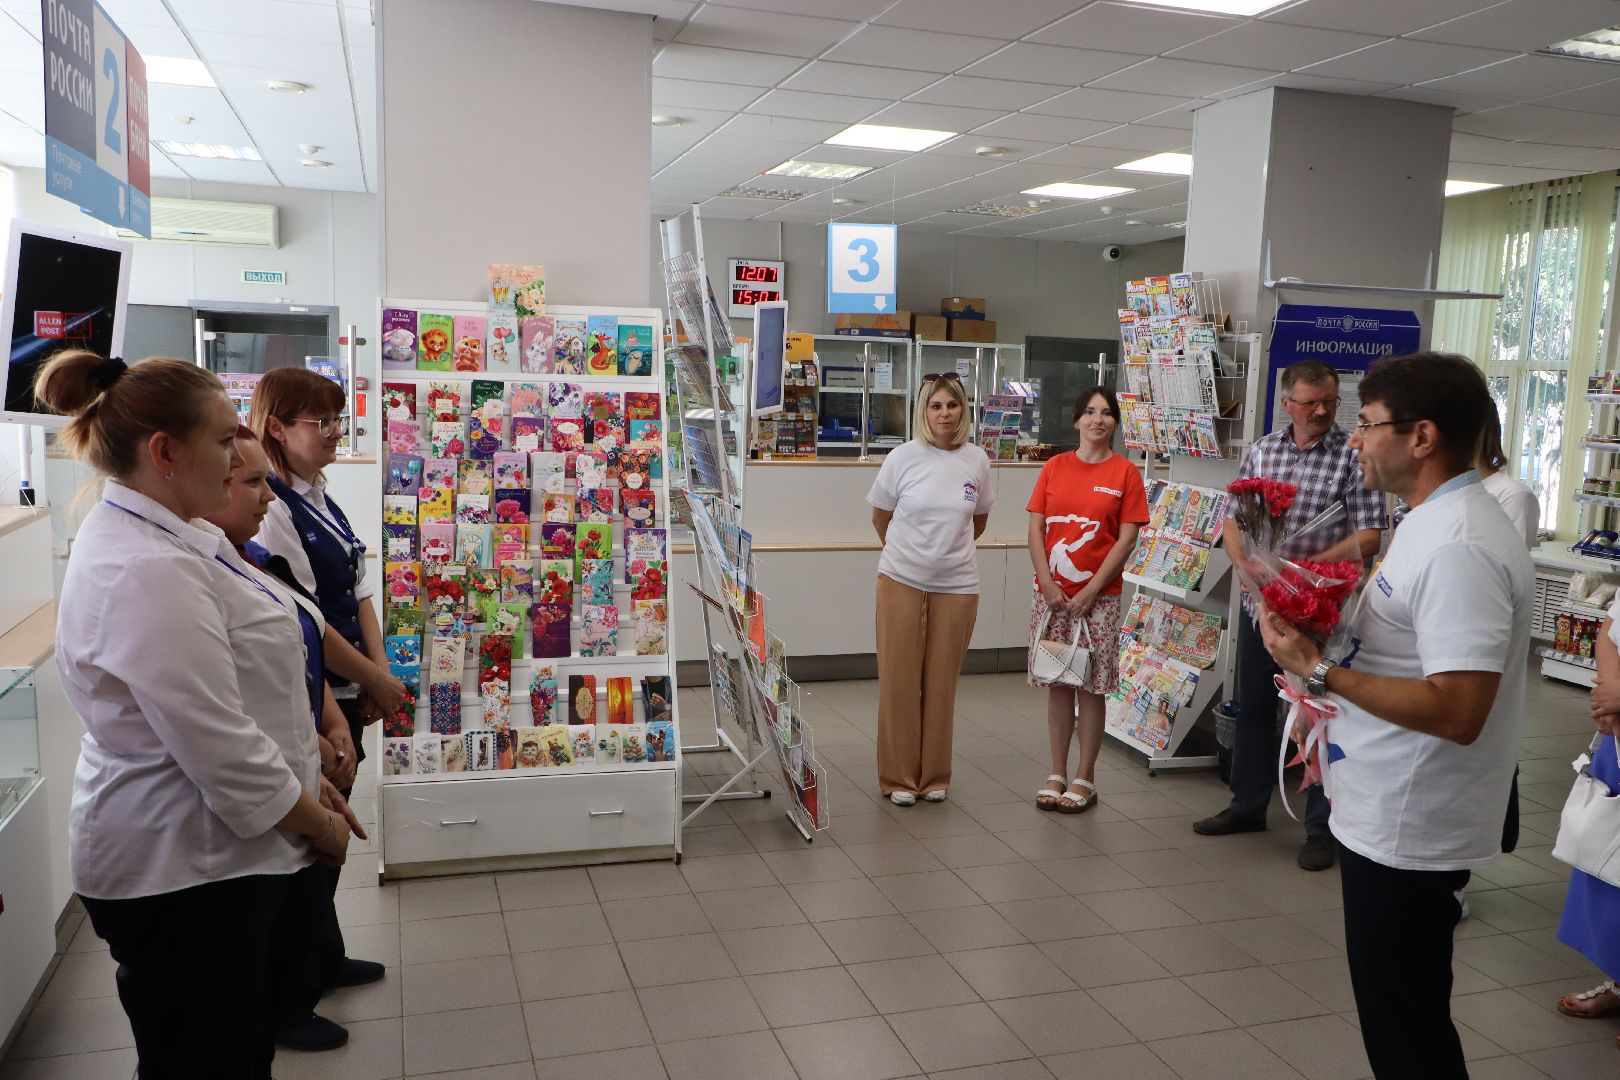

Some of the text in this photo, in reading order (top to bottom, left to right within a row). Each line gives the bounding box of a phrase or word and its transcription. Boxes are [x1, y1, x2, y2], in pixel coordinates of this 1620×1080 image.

[48, 0, 92, 65] ПОЧТА
[50, 51, 93, 117] РОССИИ
[103, 48, 121, 156] 2
[847, 237, 880, 283] 3
[246, 272, 281, 283] ВЫХОД
[741, 266, 777, 282] 12.07
[40, 317, 62, 326] ALLEN
[1317, 319, 1378, 329] ПОЧТА РОССИИ
[41, 327, 60, 335] POST
[1296, 340, 1393, 356] ИНФОРМАЦИЯ
